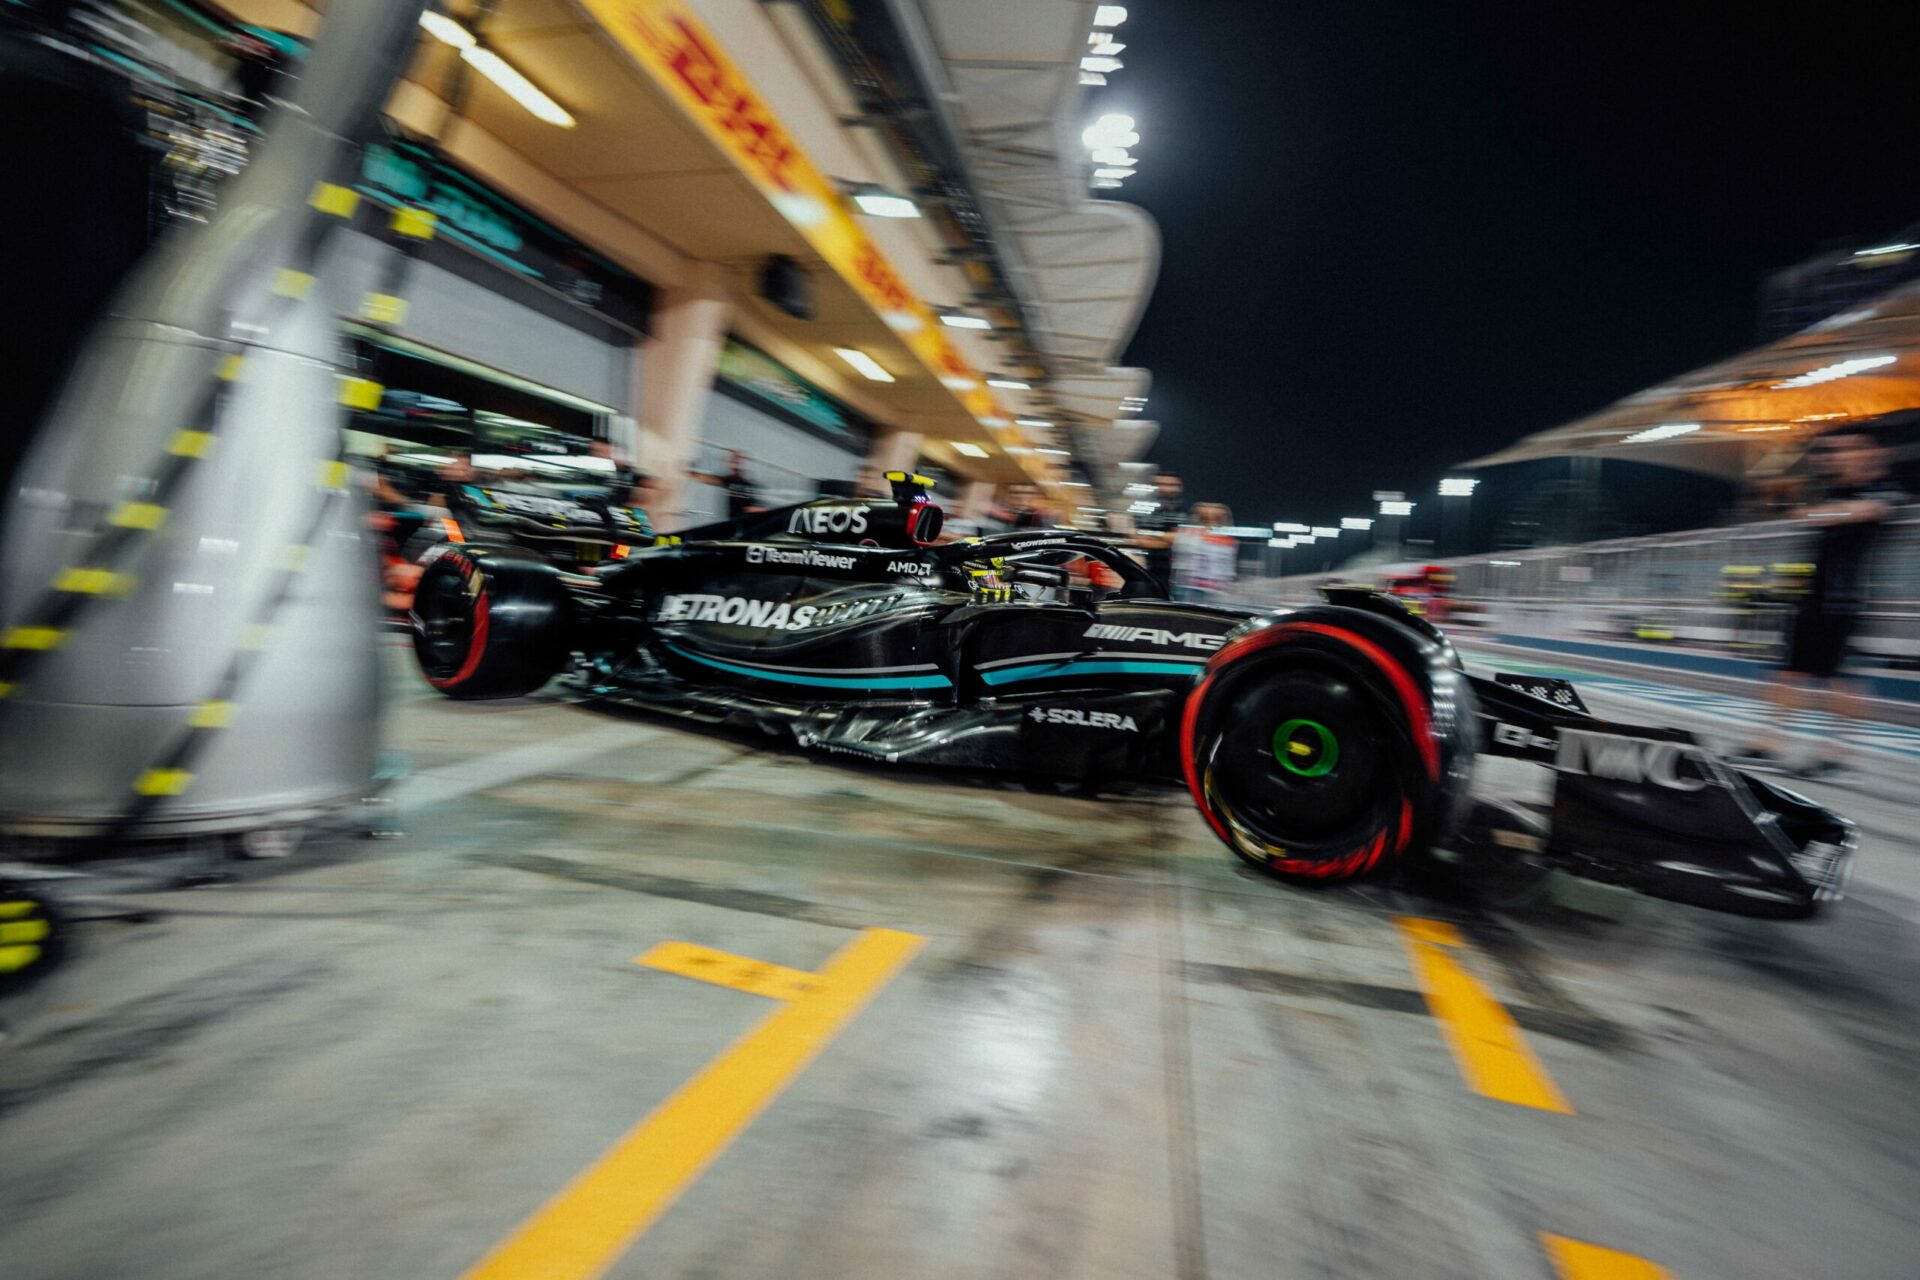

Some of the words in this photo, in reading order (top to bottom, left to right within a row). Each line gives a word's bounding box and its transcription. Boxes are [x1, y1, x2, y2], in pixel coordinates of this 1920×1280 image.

[764, 547, 857, 569] TeamViewer
[886, 561, 919, 574] AMD
[1127, 627, 1227, 650] AMG
[1047, 708, 1140, 733] SOLERA
